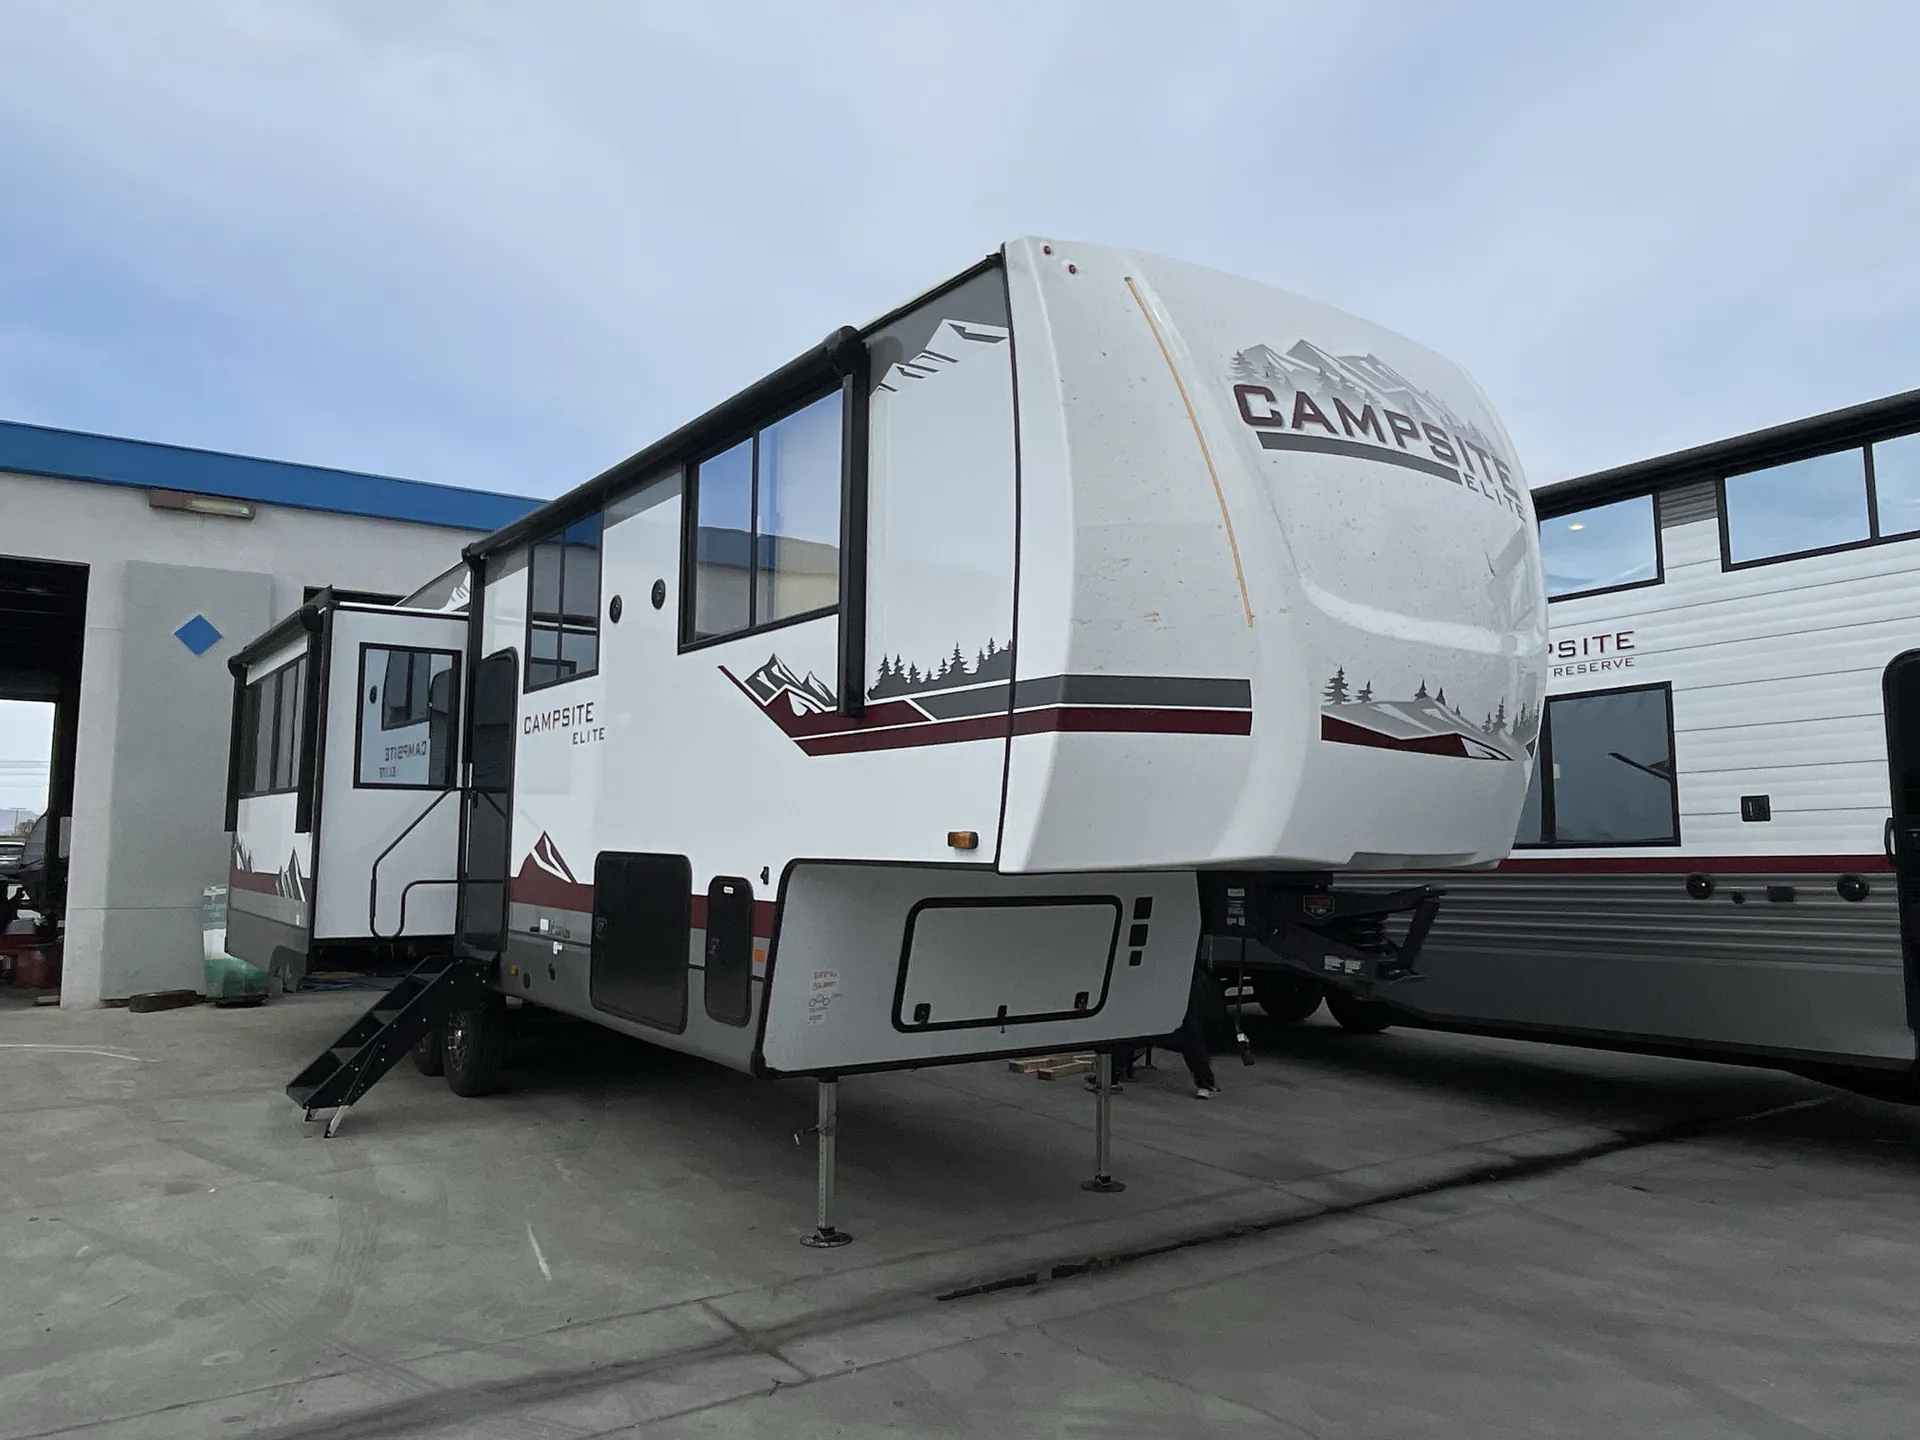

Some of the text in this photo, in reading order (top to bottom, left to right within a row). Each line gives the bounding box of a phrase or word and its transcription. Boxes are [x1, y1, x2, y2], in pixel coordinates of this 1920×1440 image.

[1233, 384, 1521, 501] CAMPSITE
[1465, 474, 1527, 523] ELITE
[1553, 657, 1635, 677] RESERVE
[524, 702, 594, 735] CAMPSITE
[572, 727, 605, 745] ELITE
